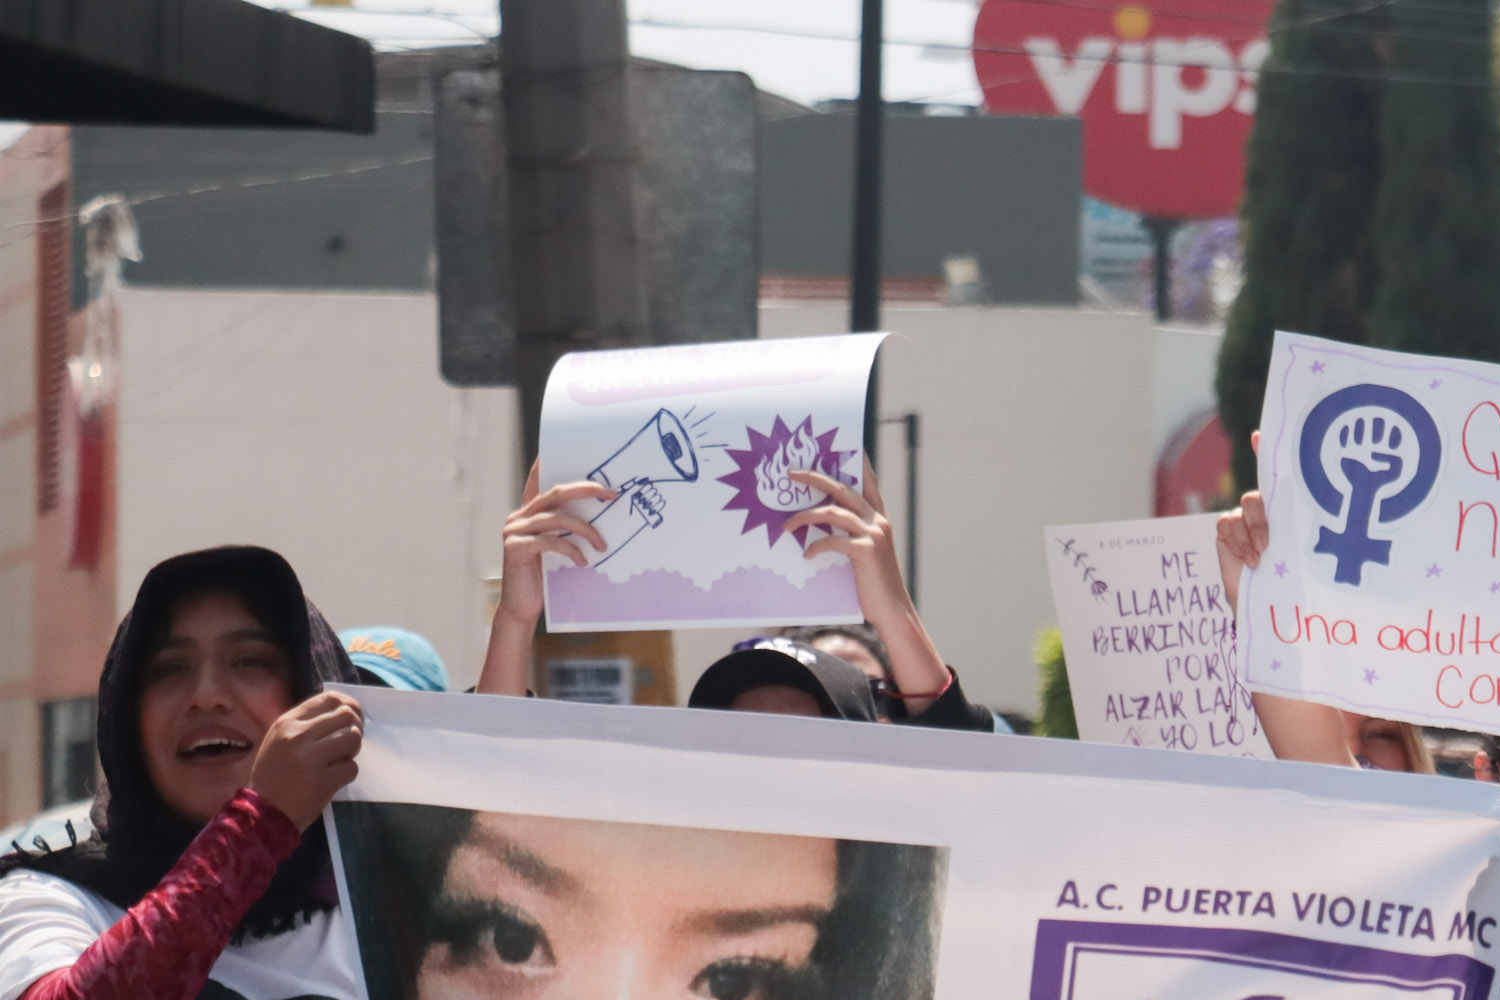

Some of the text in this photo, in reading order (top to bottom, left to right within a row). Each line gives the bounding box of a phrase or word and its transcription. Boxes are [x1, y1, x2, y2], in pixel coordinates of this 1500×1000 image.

[777, 478, 812, 506] 8M
[1126, 535, 1165, 546] MARZO
[1161, 551, 1200, 582] ME
[1116, 583, 1224, 617] LLAMAR
[1092, 617, 1228, 656] BERRINCH
[1269, 605, 1358, 646] Una
[1106, 689, 1188, 723] ALZAR
[1160, 719, 1245, 750] YO LO
[1142, 886, 1276, 918] PUERTA
[1292, 892, 1436, 941] VIOLETA
[1448, 910, 1498, 949] MC
